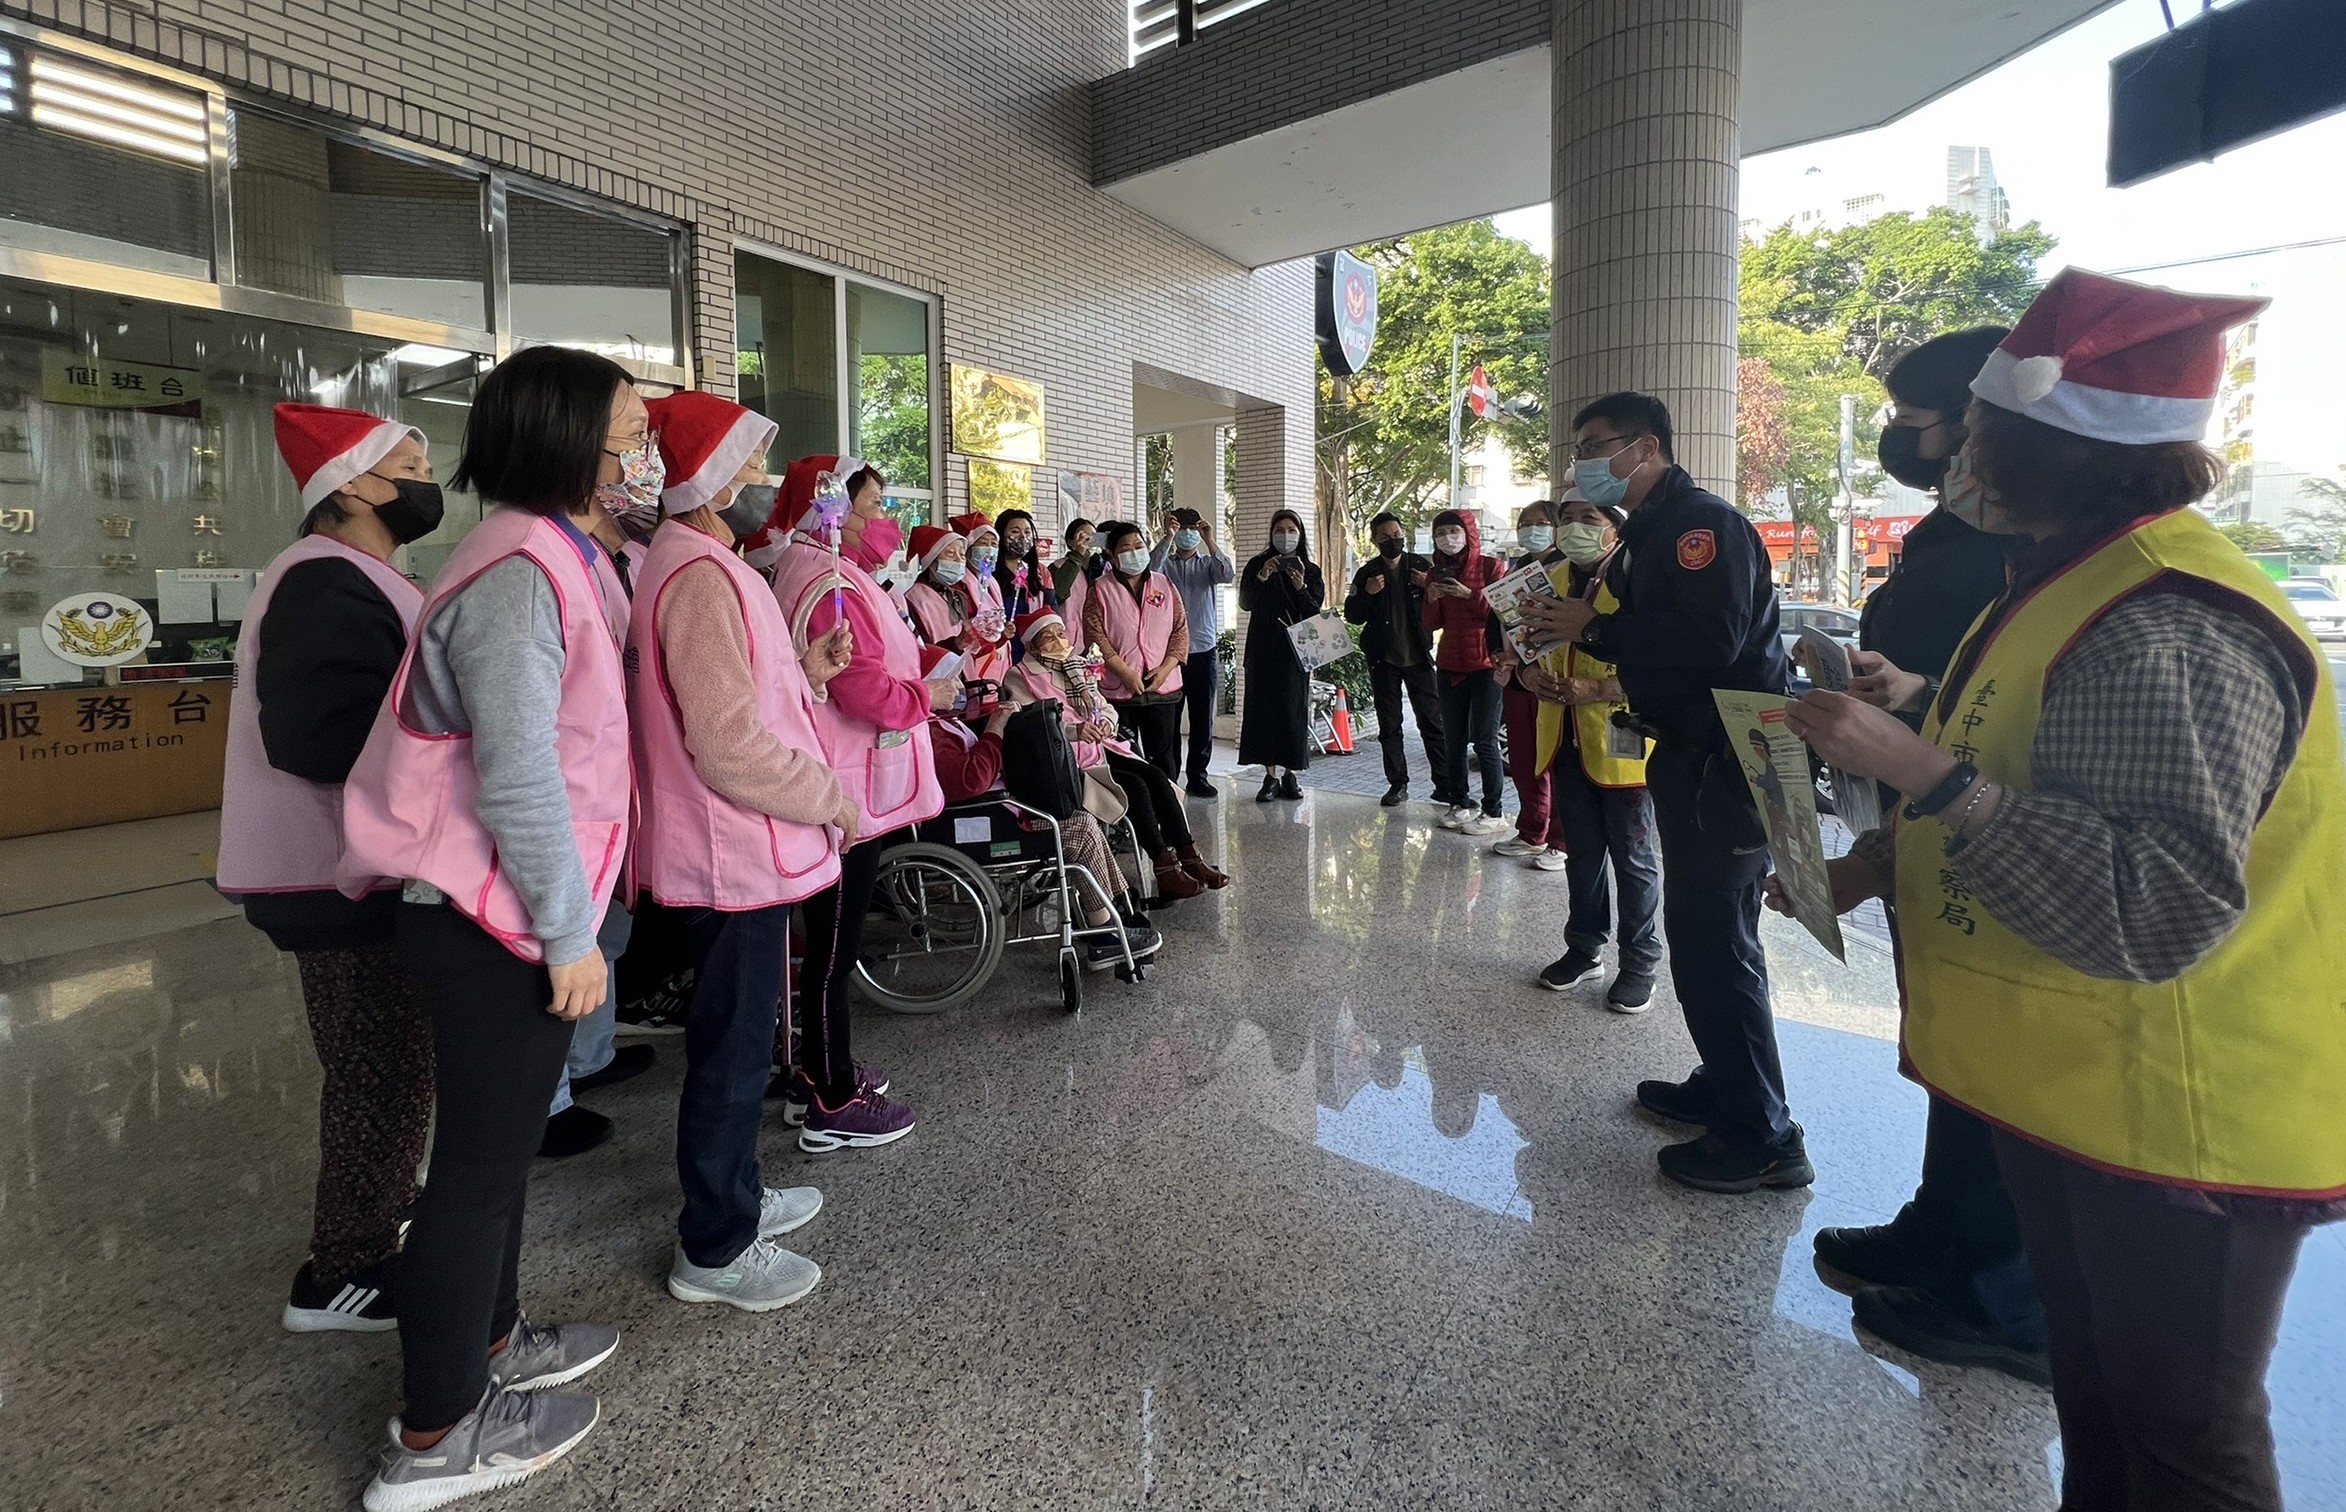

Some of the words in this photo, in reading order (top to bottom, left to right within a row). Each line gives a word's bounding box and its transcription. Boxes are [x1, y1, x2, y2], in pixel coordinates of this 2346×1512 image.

[1344, 326, 1367, 353] POLICE
[1766, 529, 1795, 539] Run
[20, 733, 184, 761] Information
